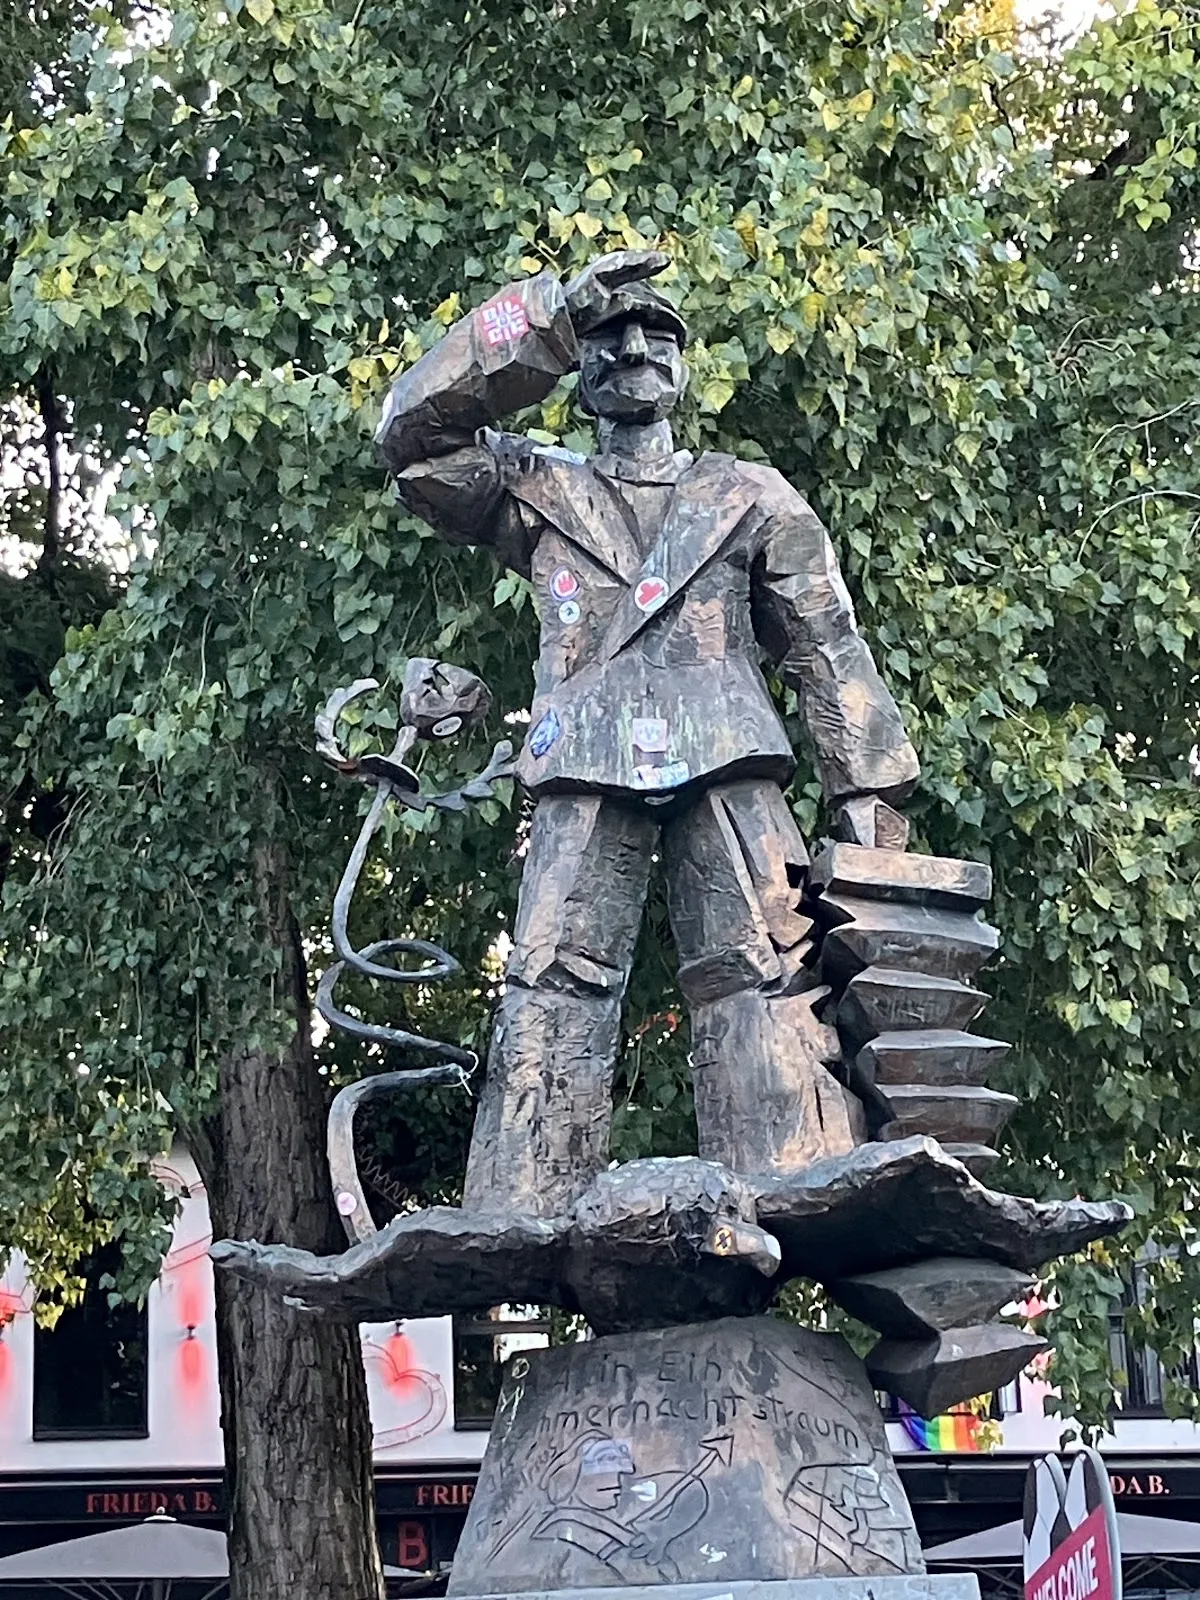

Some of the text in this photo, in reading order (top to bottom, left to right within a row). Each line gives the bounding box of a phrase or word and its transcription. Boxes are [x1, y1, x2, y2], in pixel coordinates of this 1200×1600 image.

[86, 1490, 217, 1513] FRIEDA B.
[1148, 1474, 1170, 1495] B.
[398, 1520, 428, 1567] B
[1033, 1536, 1099, 1600] ELCOME
